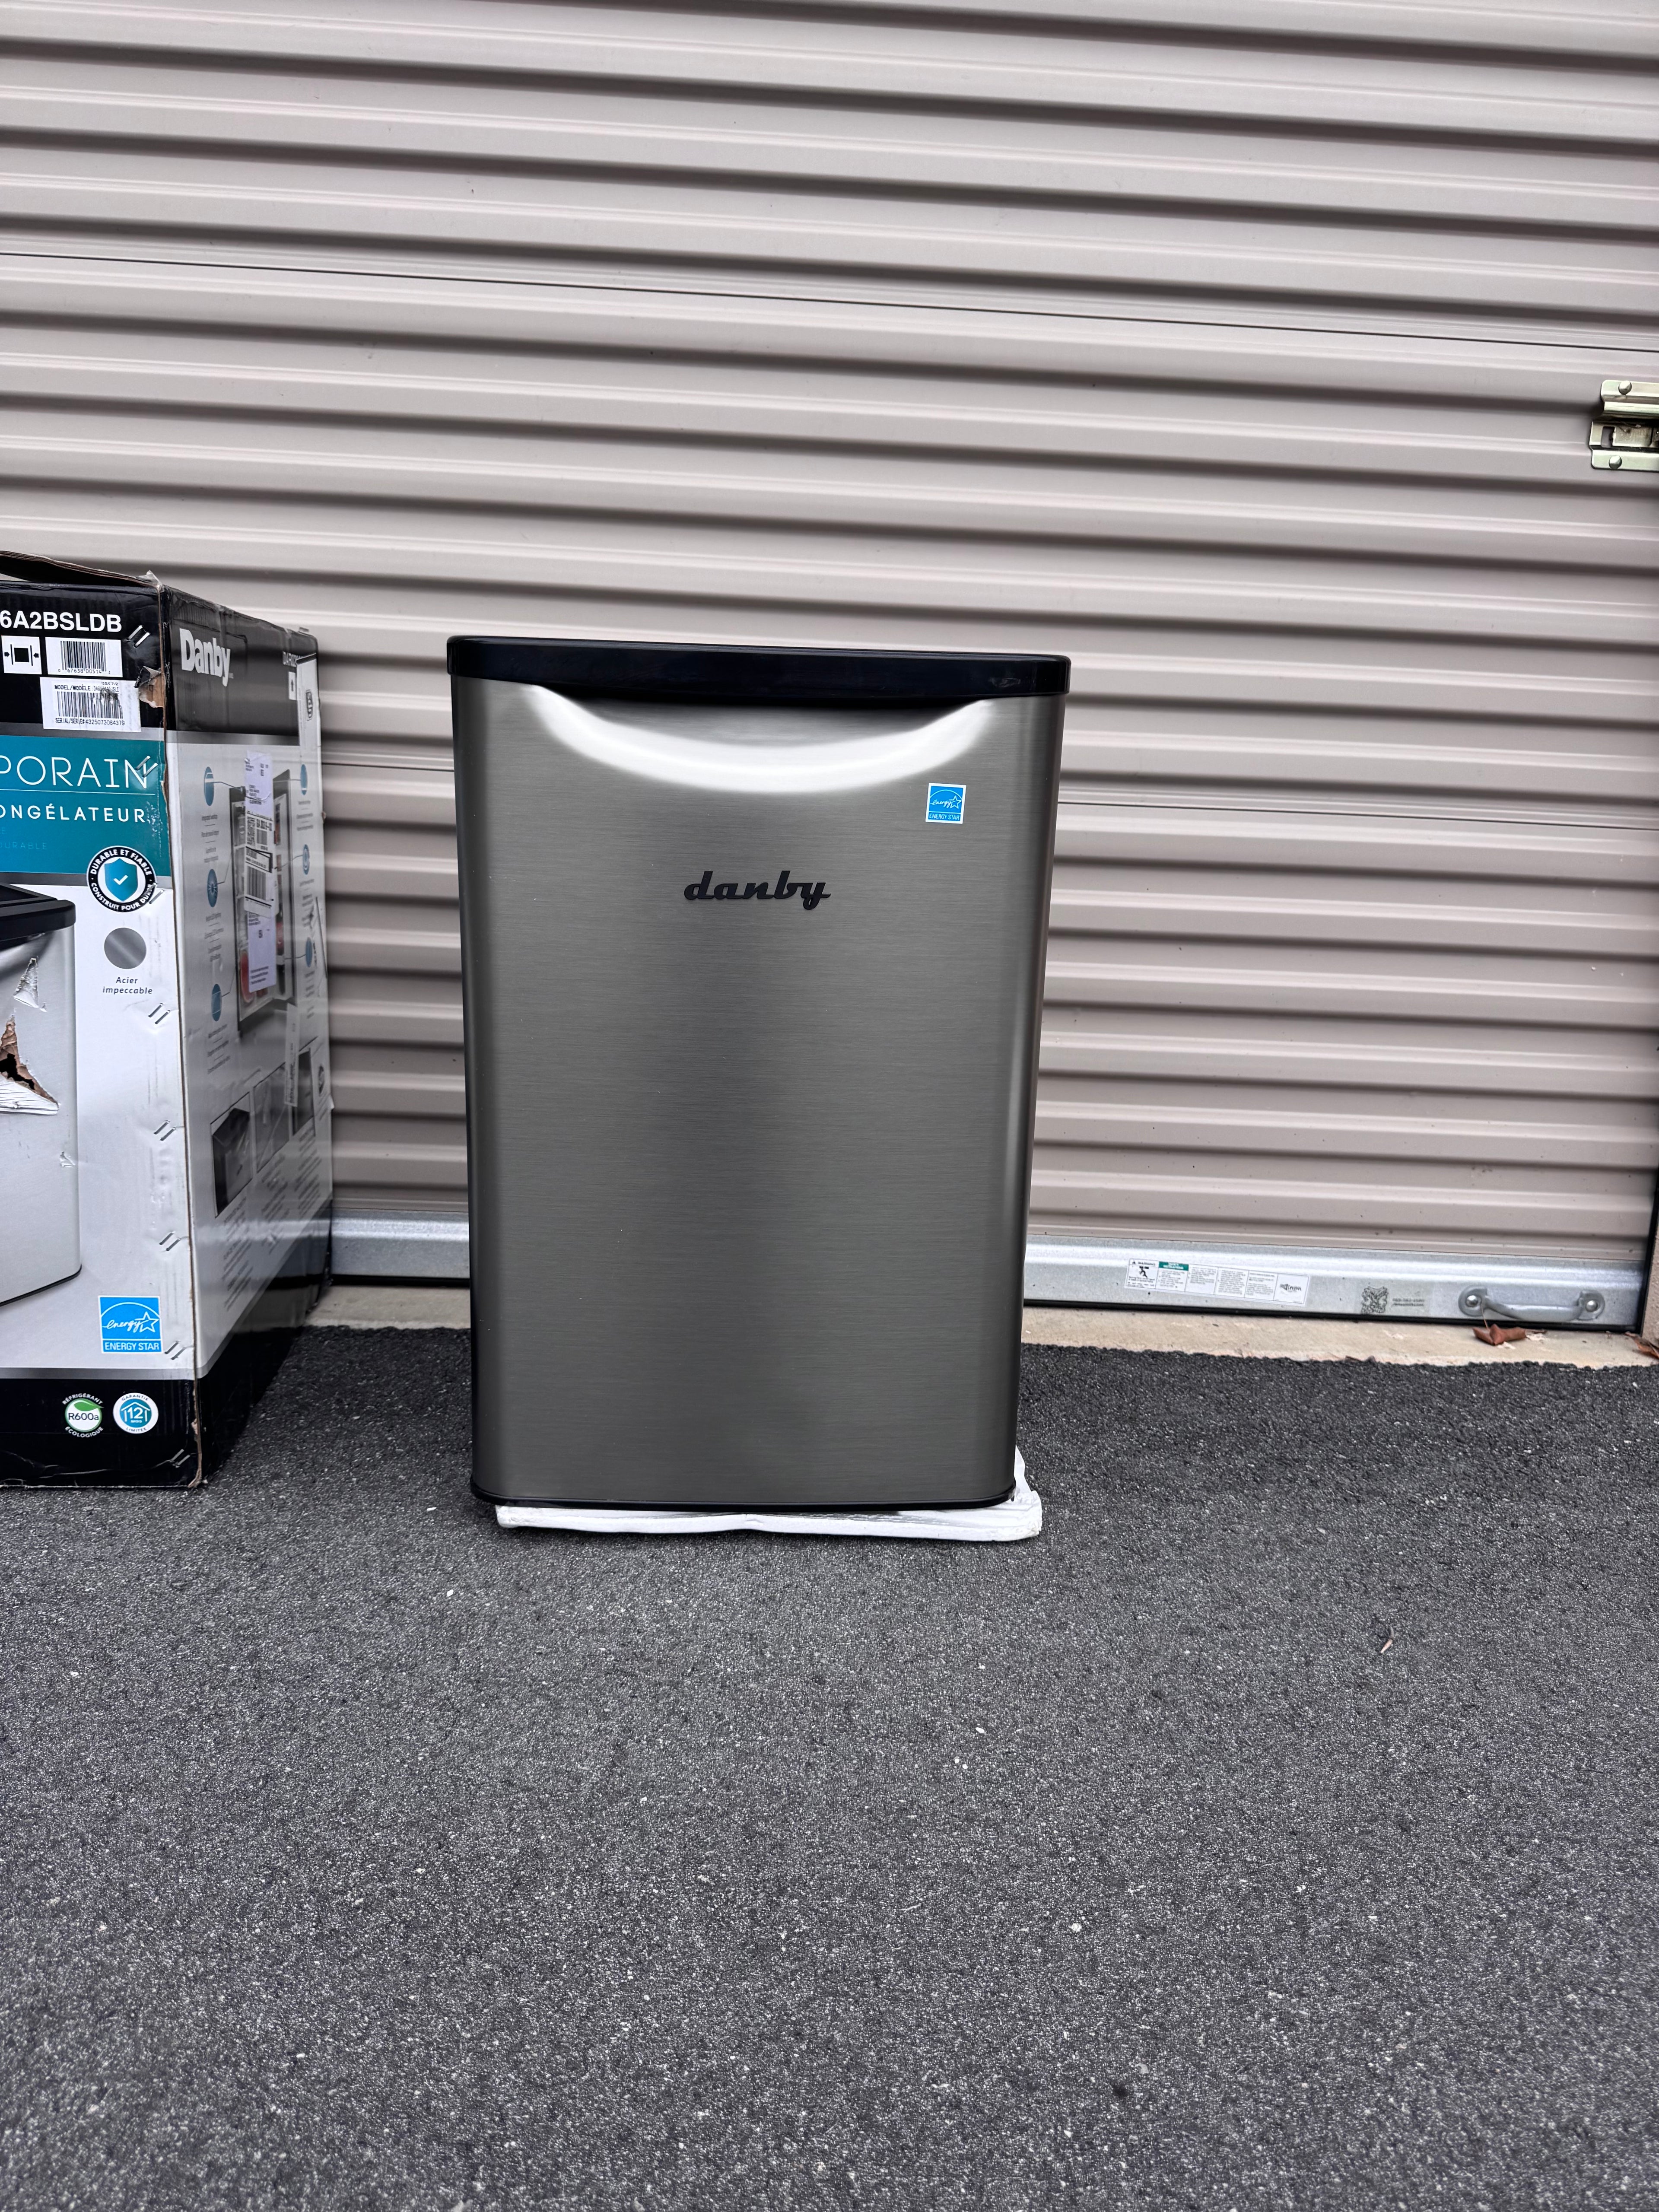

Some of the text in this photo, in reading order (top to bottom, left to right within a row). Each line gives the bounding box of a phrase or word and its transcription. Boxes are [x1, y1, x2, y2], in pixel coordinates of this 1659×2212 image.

[0, 610, 122, 632] 6A2BSLDB
[179, 628, 231, 687] Danby
[930, 799, 954, 808] energy
[90, 849, 118, 875] DURABLE
[130, 852, 152, 875] FIABLE
[91, 883, 120, 910] CONSTRUIT
[121, 902, 141, 911] POUR
[684, 871, 831, 910] danby
[103, 986, 153, 995] impeccable
[102, 1319, 146, 1333] energy
[62, 1393, 103, 1405] RÉFRIGÉRANT
[127, 1407, 143, 1419] 12
